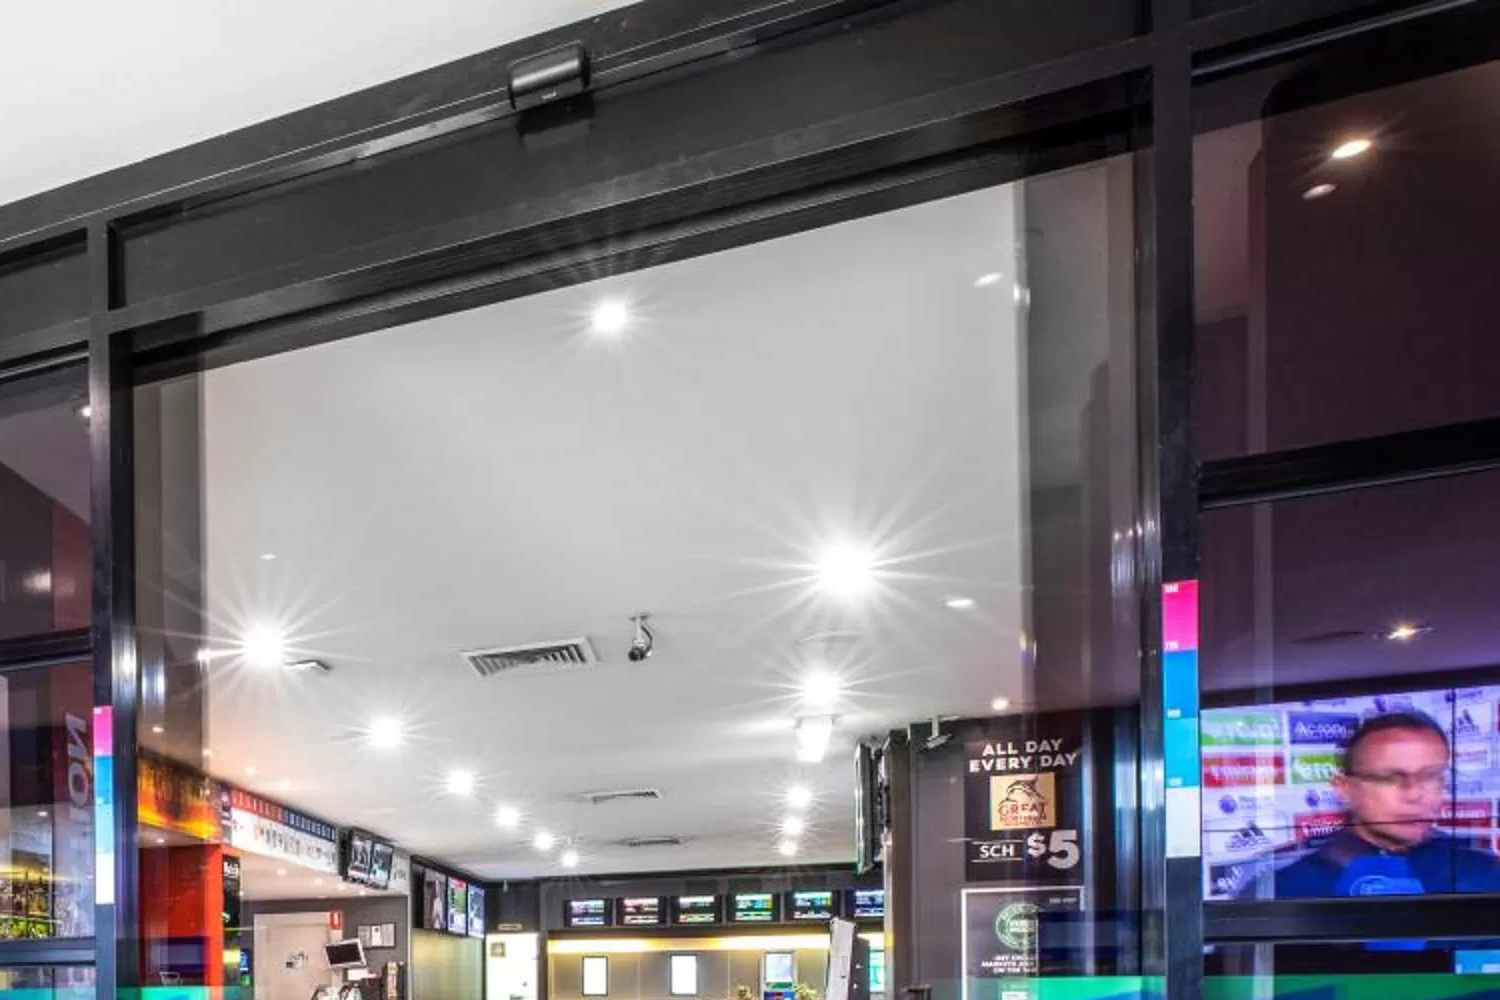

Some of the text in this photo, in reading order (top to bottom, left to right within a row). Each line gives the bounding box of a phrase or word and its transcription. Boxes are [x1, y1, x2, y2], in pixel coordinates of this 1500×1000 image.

[982, 739, 1062, 757] ALL DAY
[969, 753, 1077, 773] EVERY DAY
[979, 829, 1080, 869] SCH $5
